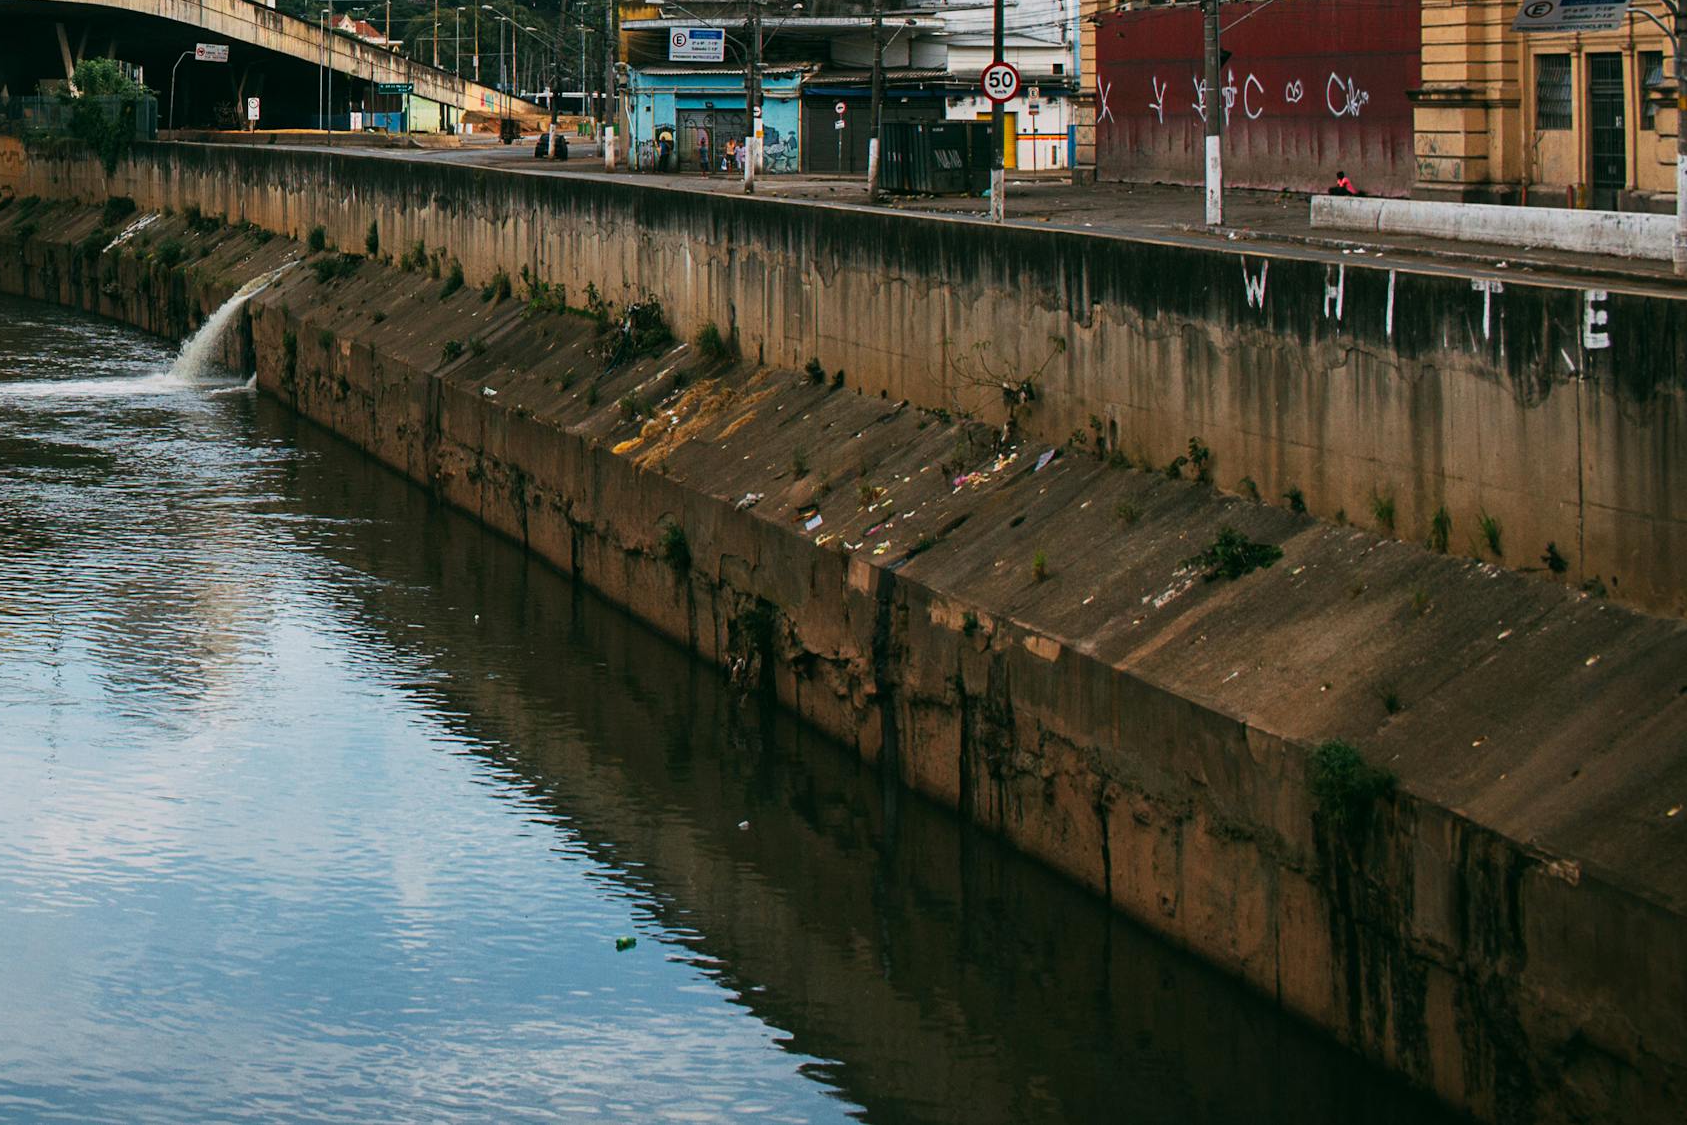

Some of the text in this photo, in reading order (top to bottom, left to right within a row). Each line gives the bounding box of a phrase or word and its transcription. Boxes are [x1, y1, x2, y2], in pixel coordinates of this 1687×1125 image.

[1532, 4, 1545, 15] E
[676, 36, 682, 44] E
[989, 71, 1013, 88] 50
